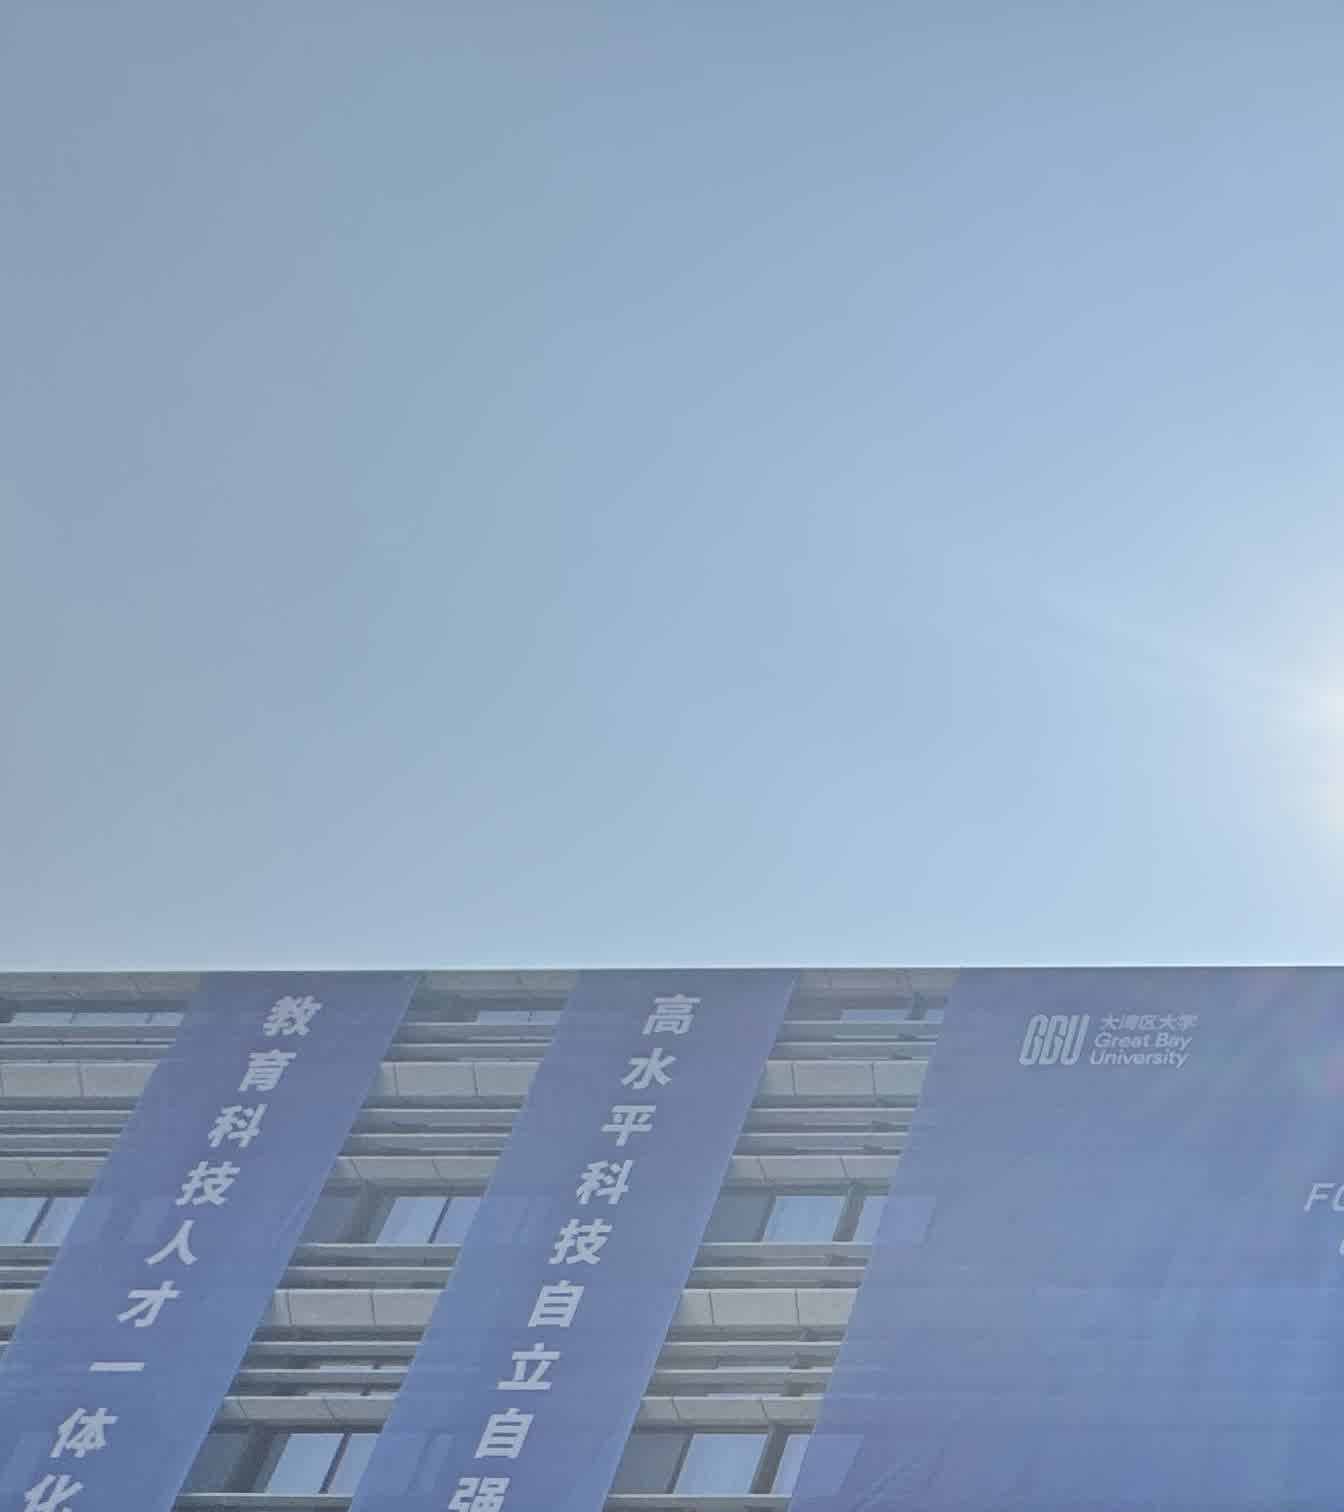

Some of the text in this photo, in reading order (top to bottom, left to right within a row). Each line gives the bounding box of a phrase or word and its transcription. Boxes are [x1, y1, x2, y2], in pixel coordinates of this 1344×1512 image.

[1095, 1031, 1193, 1052] Great Bay
[1090, 1050, 1190, 1069] University
